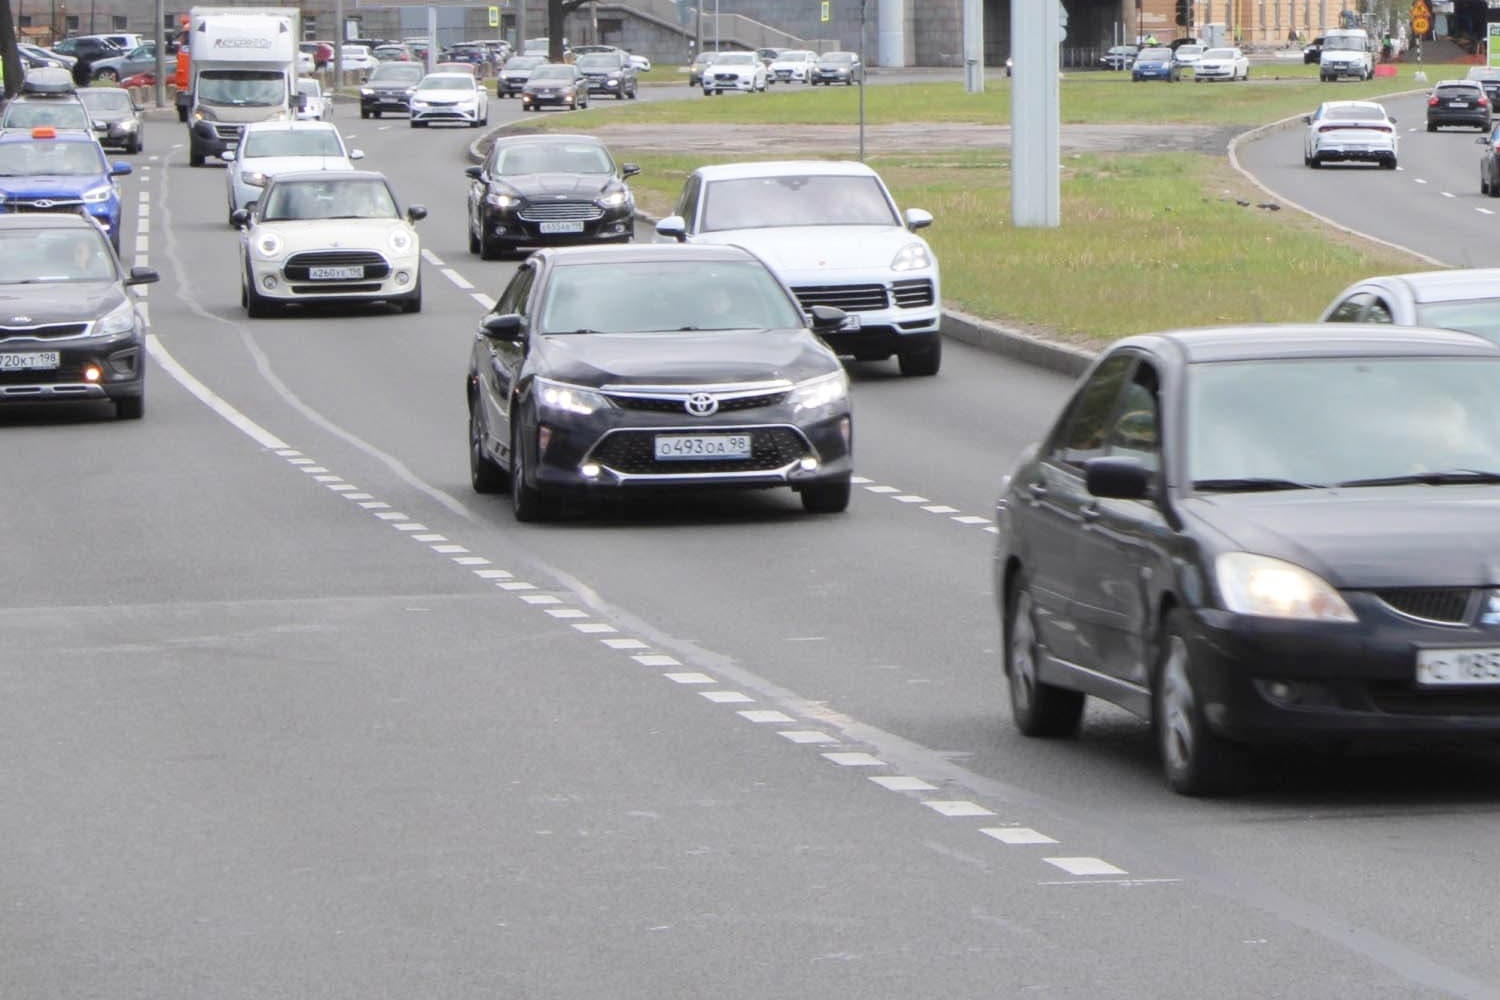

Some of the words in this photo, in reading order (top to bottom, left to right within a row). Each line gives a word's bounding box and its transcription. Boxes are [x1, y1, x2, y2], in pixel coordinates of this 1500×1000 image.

[1415, 21, 1426, 29] 40
[40, 353, 56, 362] 198
[729, 437, 746, 449] 98
